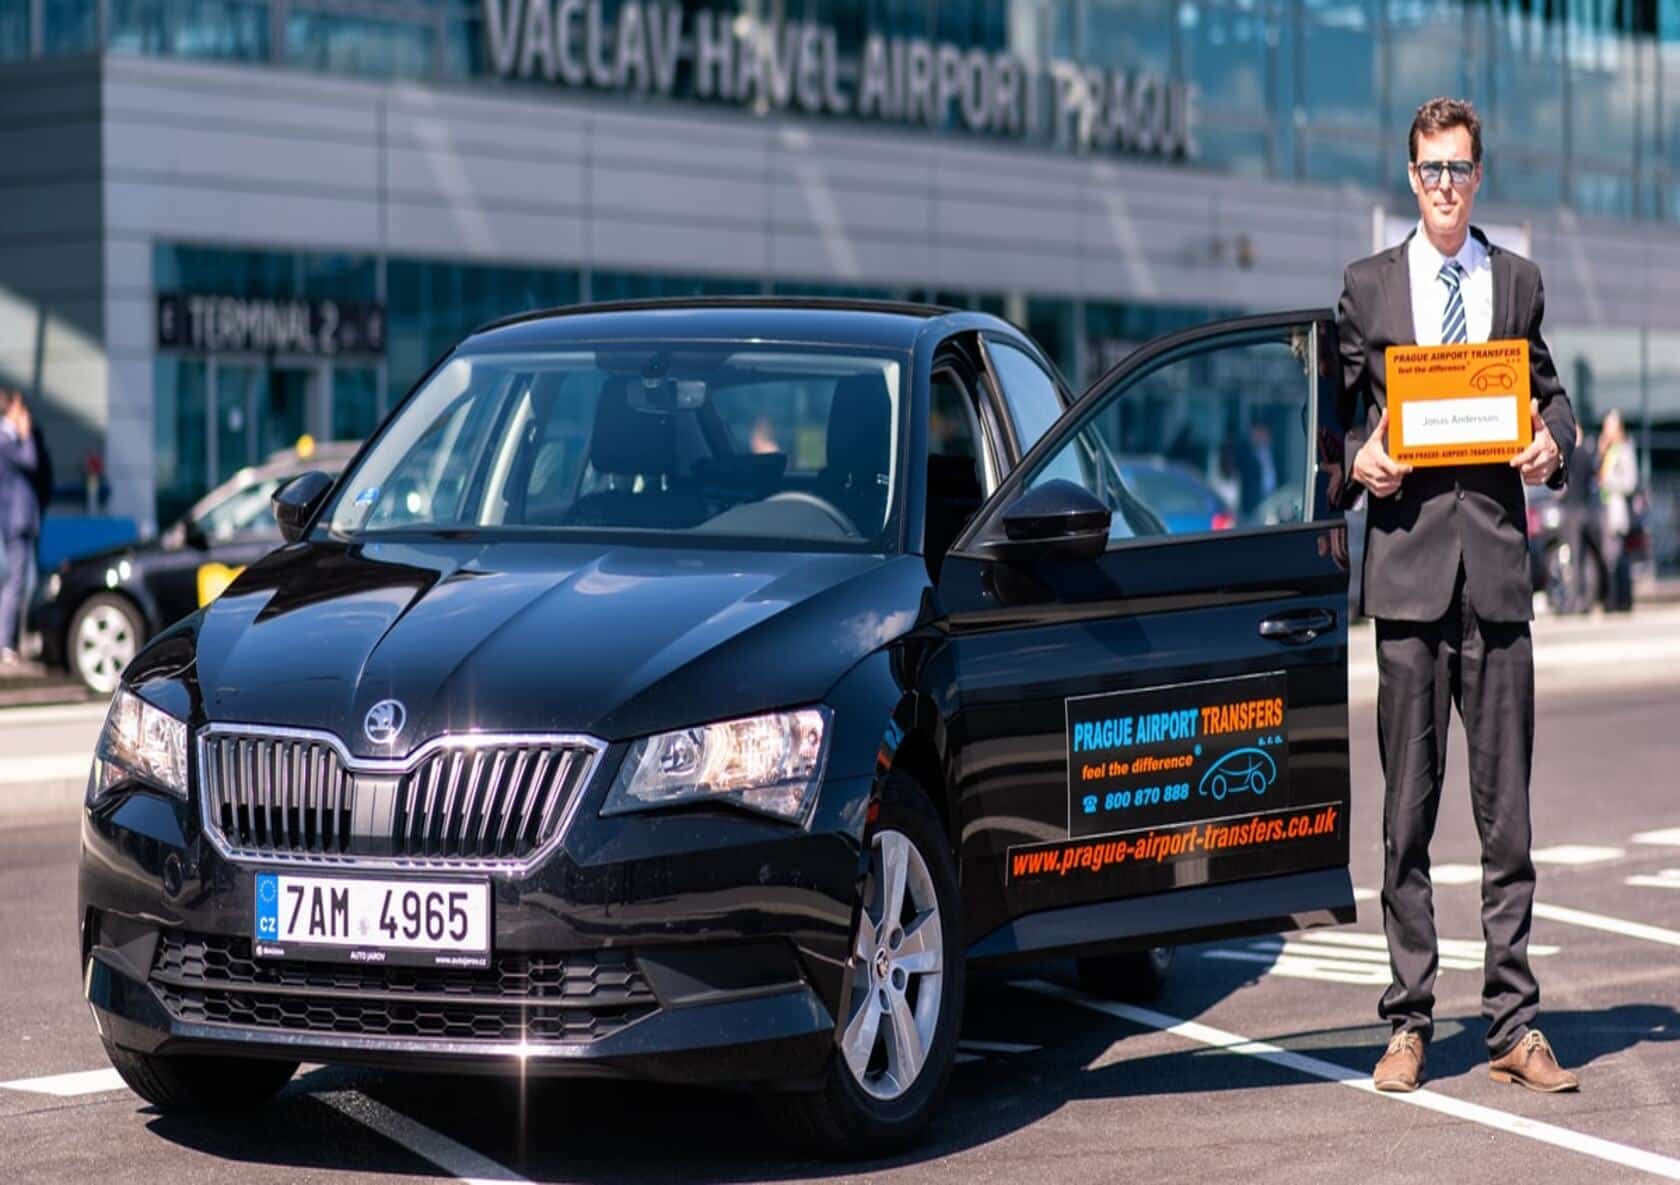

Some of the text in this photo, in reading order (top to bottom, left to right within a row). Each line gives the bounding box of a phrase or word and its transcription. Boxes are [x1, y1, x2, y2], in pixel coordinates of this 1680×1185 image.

[697, 8, 849, 115] HAVEL
[859, 33, 1040, 137] AIRPORT
[1051, 58, 1203, 160] PRAGUE
[189, 296, 315, 351] TERMINAL
[319, 299, 339, 352] 2
[1393, 347, 1521, 363] PRAGUE AIRPORT TRANSFERS
[1414, 365, 1426, 374] the
[1428, 364, 1466, 374] difference
[1073, 697, 1284, 753] PRAGUE AIRPORT TRANSFERS
[1081, 754, 1194, 781] feel the difference
[1104, 783, 1190, 811] 800 870 888
[1012, 806, 1337, 877] www.prague-airport-transfers.co.uk
[260, 917, 276, 934] CZ
[286, 885, 469, 943] 7AM 4965
